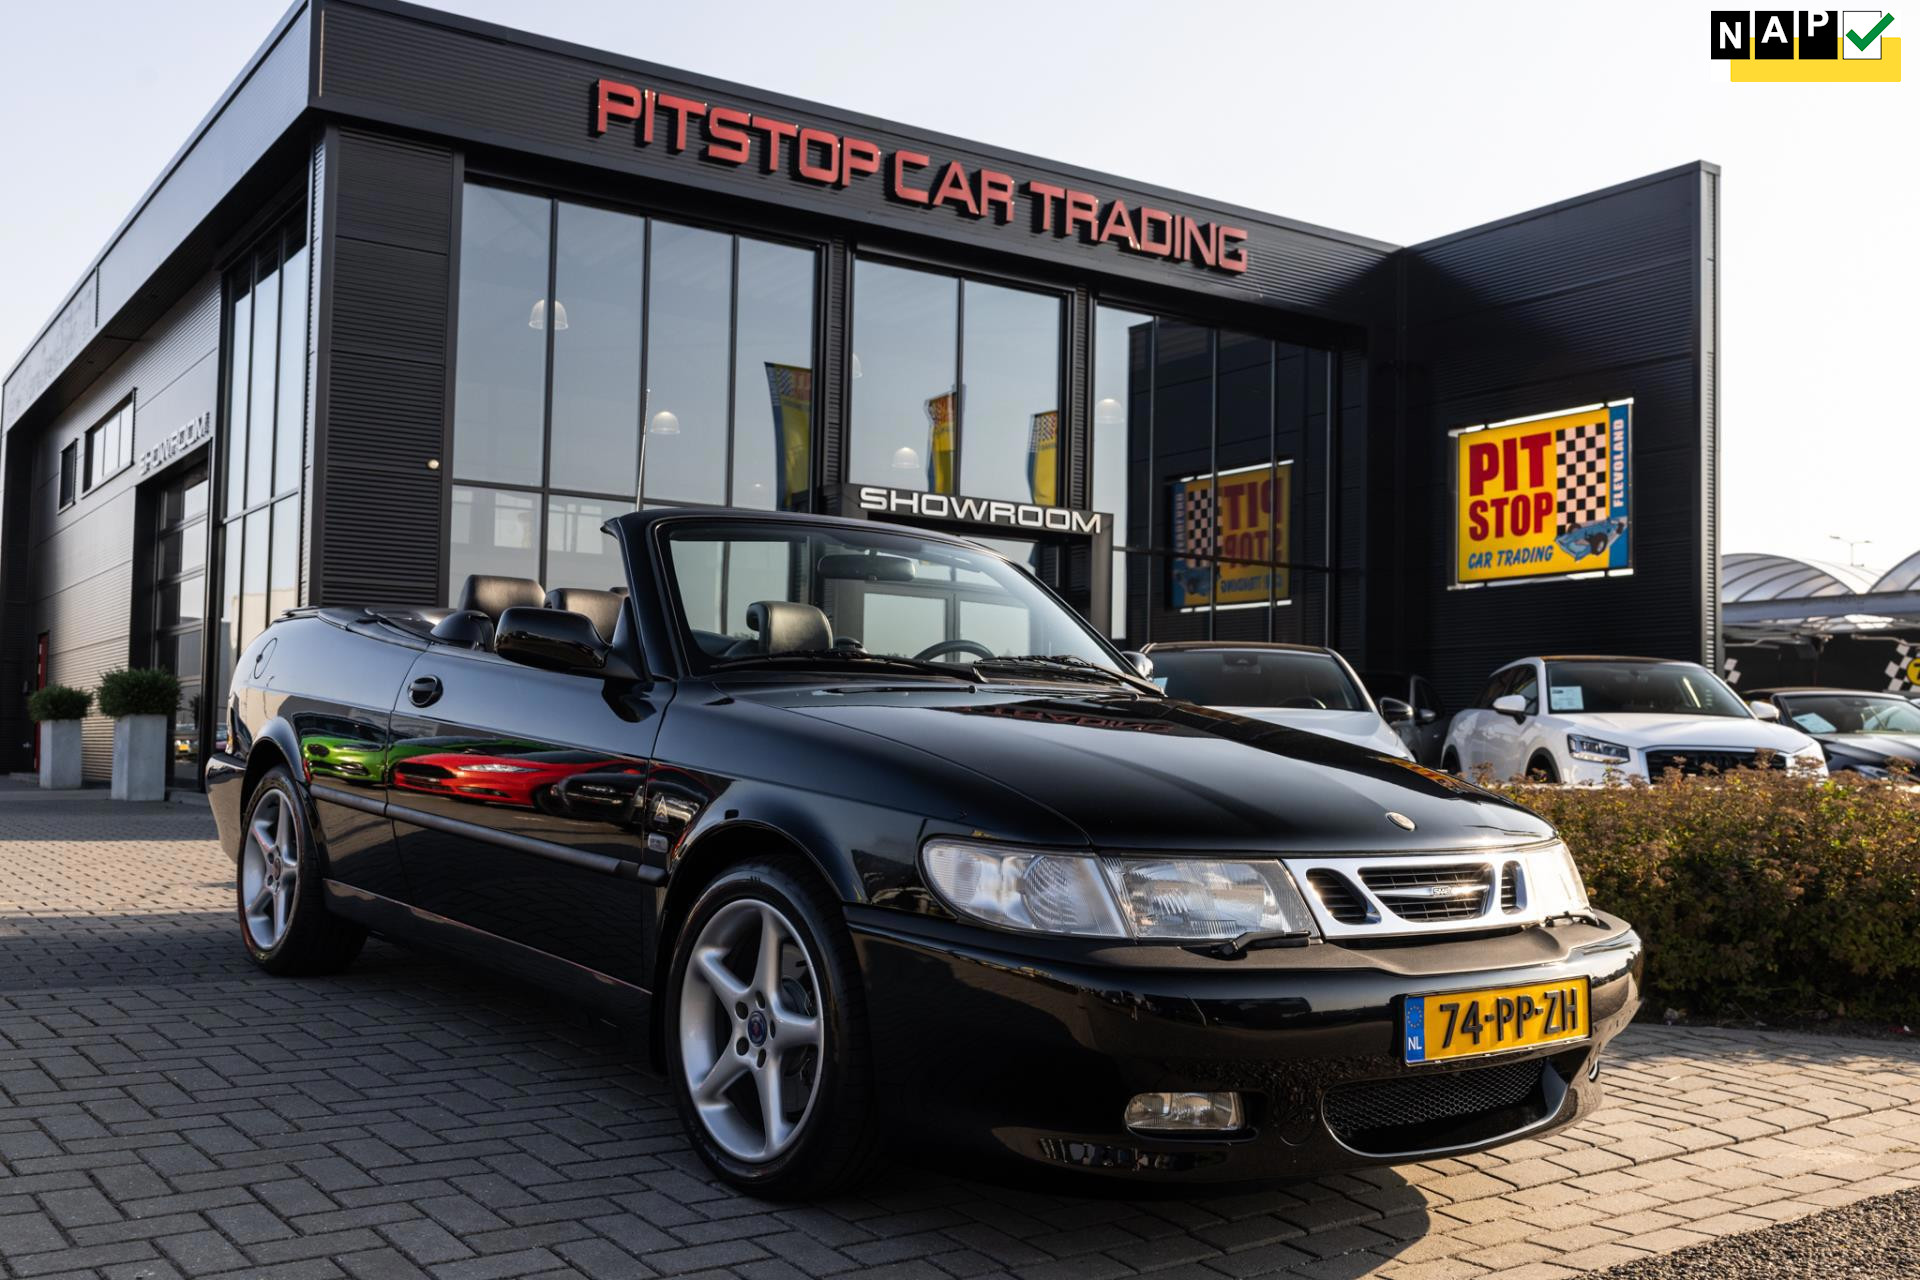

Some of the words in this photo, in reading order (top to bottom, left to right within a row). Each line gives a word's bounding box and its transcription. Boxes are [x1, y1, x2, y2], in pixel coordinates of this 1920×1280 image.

[595, 79, 882, 187] PITSTOP
[893, 150, 1015, 223] CAR
[1028, 180, 1248, 274] TRADING
[1468, 432, 1552, 497] PIT
[1612, 418, 1625, 508] FLEVOLAND
[859, 487, 1101, 533] SHOWROOM
[1468, 491, 1554, 542] STOP
[1467, 551, 1493, 570] CAR
[1496, 545, 1554, 567] TRADING
[1407, 1036, 1423, 1051] NL
[1439, 987, 1578, 1049] 74-PP-ZH
